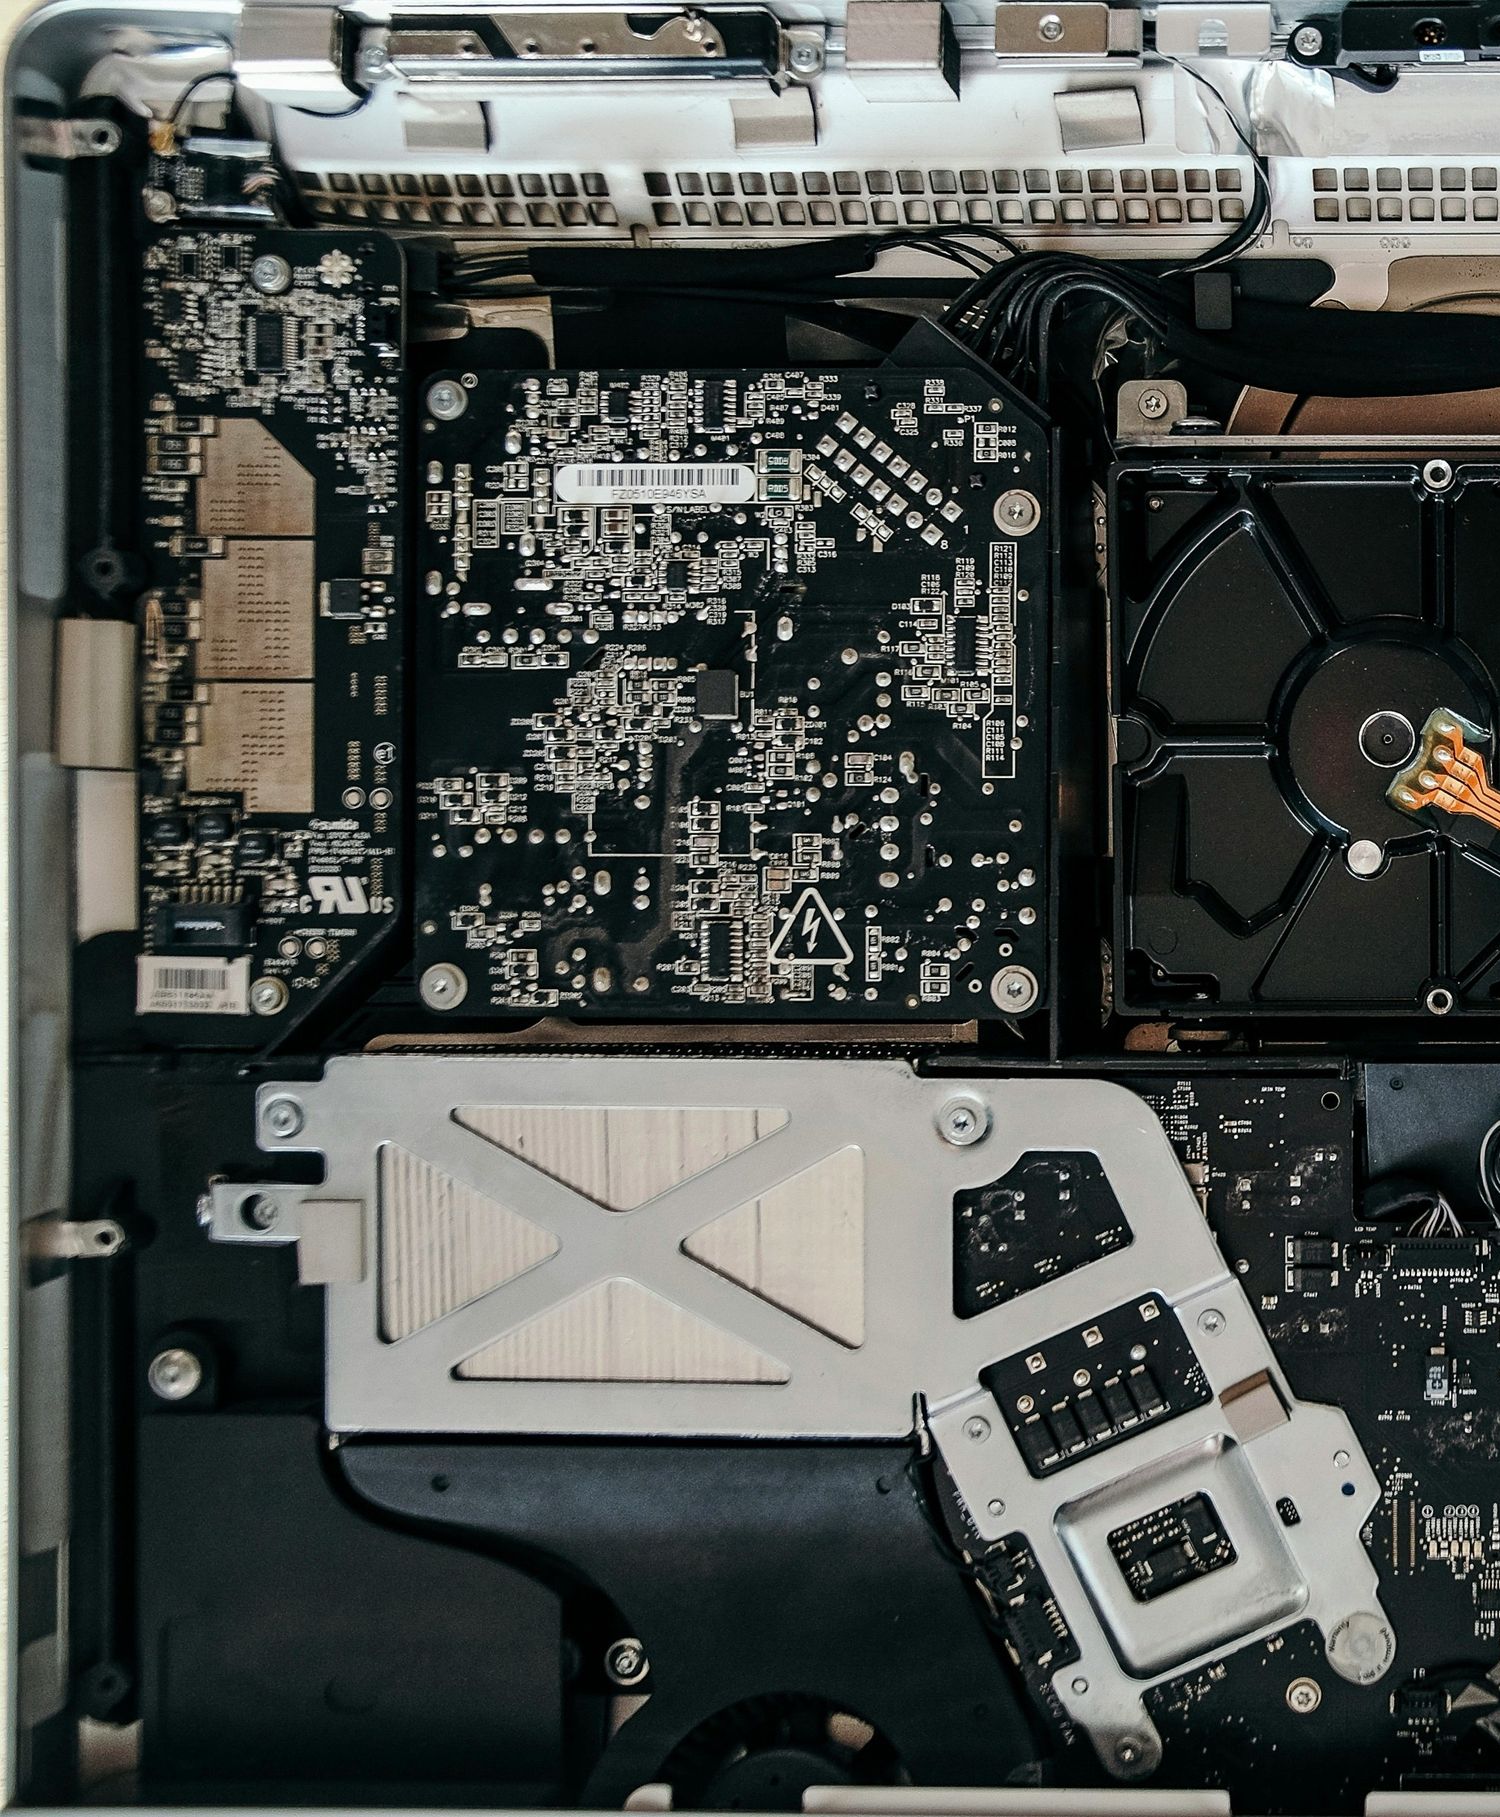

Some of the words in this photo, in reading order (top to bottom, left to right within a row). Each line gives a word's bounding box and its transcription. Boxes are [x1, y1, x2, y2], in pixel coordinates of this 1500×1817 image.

[964, 526, 968, 534] 1
[940, 540, 948, 549] 8
[370, 897, 394, 914] US
